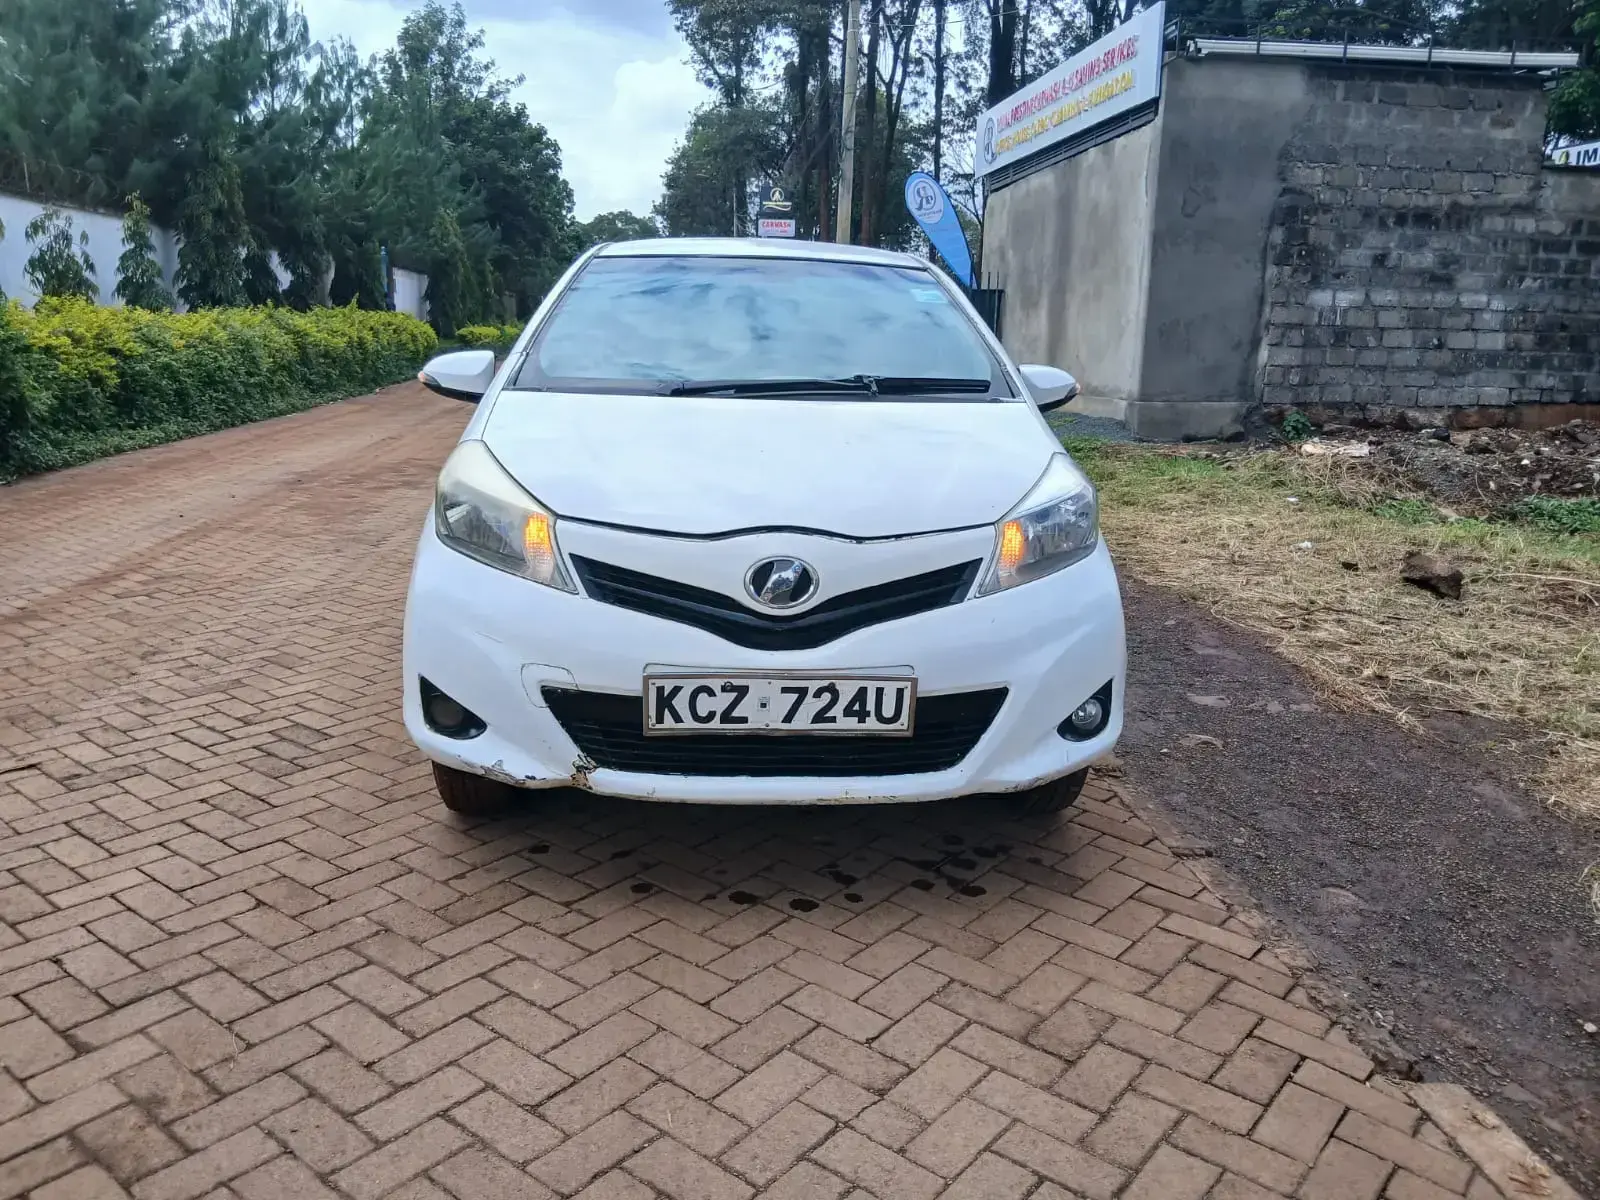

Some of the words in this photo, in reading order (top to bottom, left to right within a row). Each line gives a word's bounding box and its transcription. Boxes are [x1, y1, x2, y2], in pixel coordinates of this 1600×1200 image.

[1576, 147, 1600, 165] IM
[655, 684, 750, 725] KCZ
[780, 684, 904, 725] 724U
